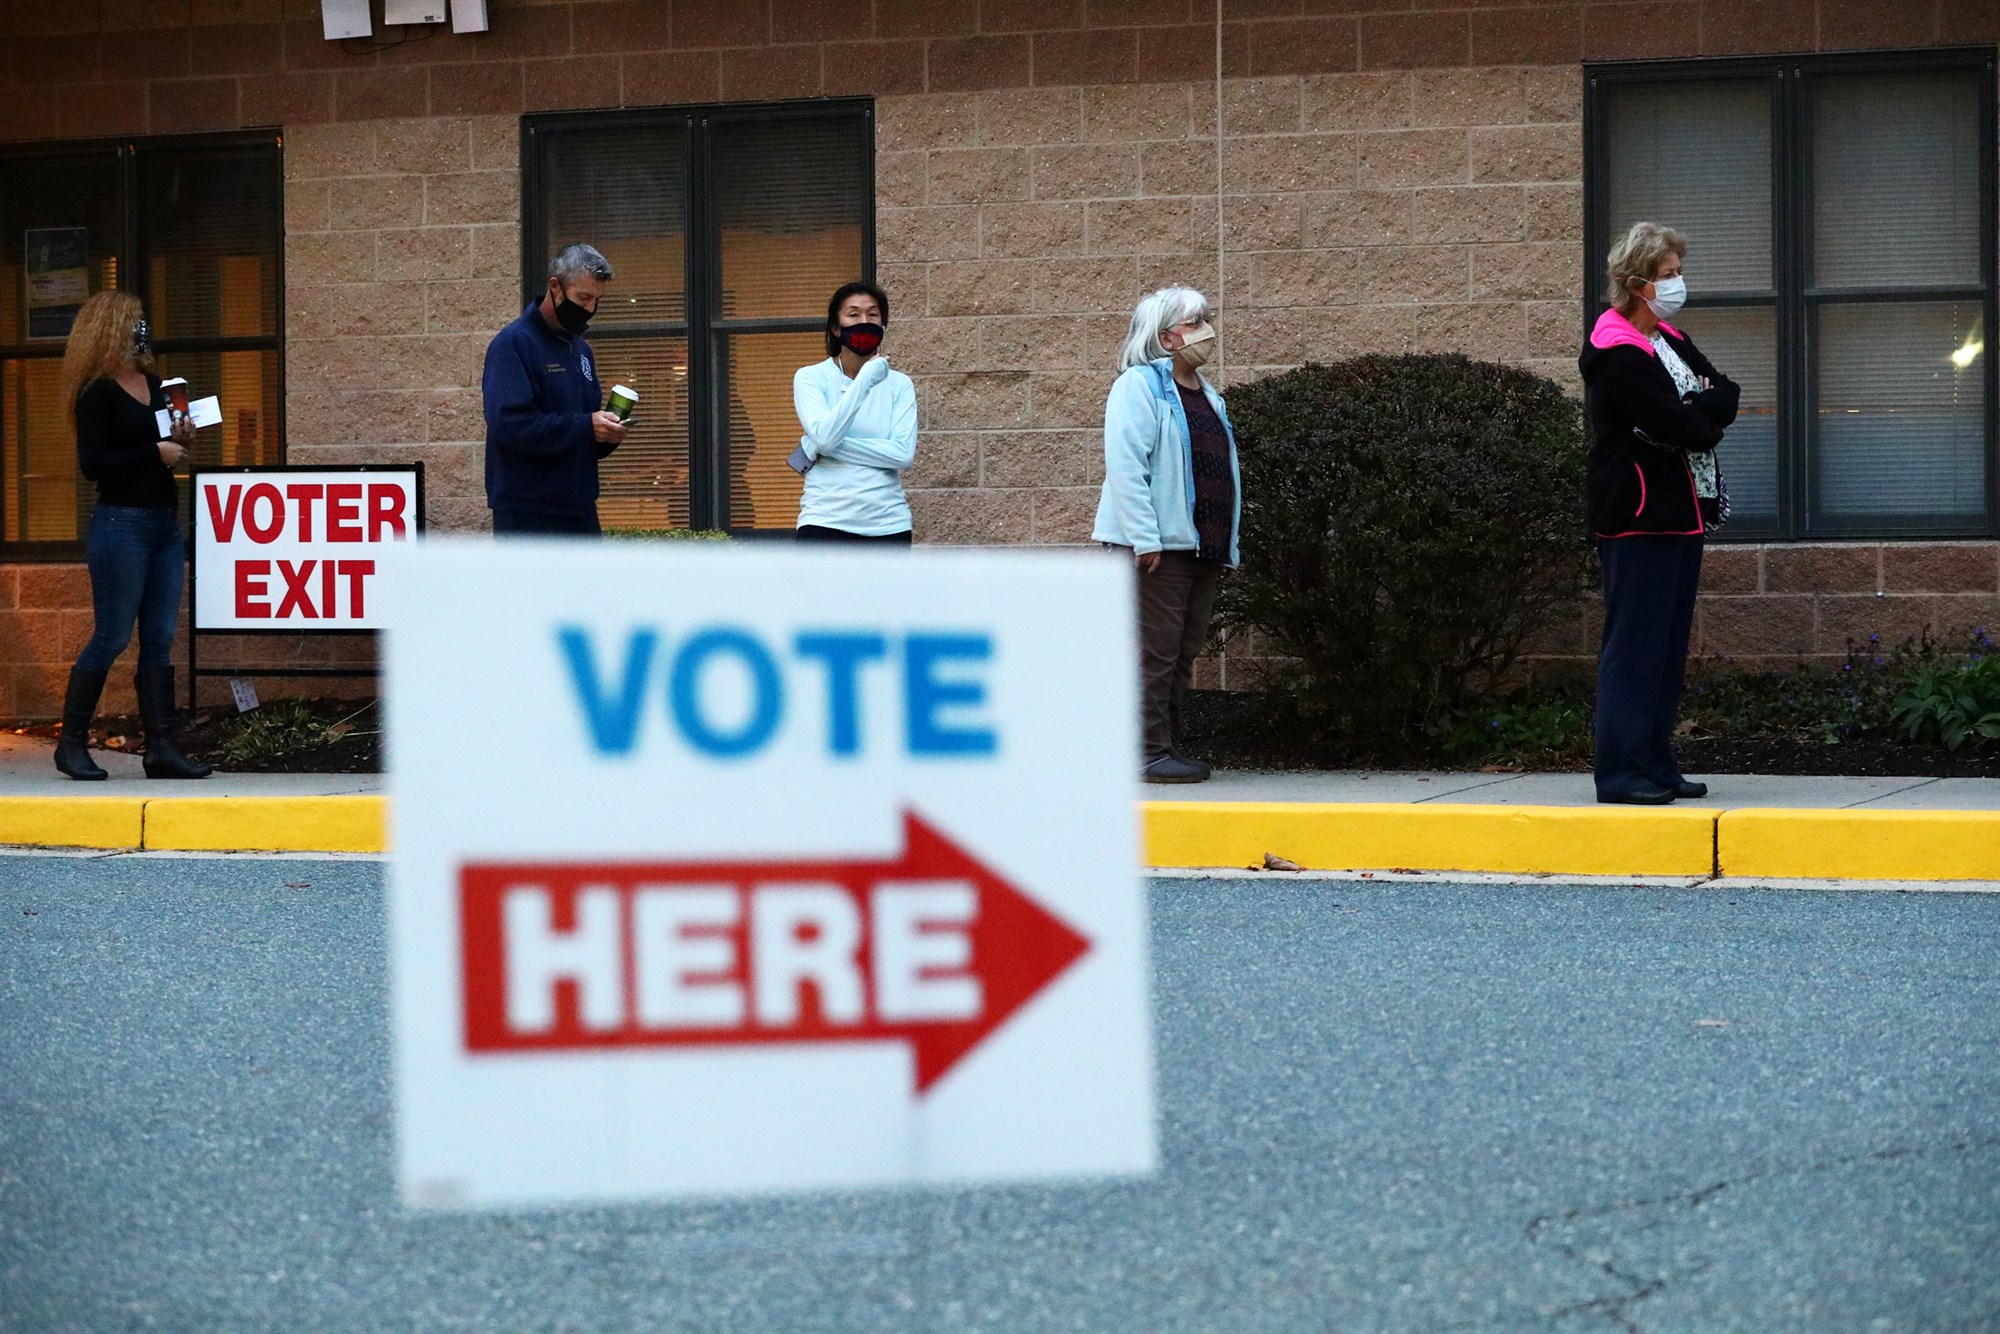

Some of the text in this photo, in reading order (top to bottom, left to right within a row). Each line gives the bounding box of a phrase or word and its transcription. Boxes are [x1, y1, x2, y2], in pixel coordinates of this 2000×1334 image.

[204, 483, 406, 544] VOTER
[235, 560, 375, 619] EXIT
[556, 624, 998, 758] VOTE
[505, 883, 984, 1033] HERE
